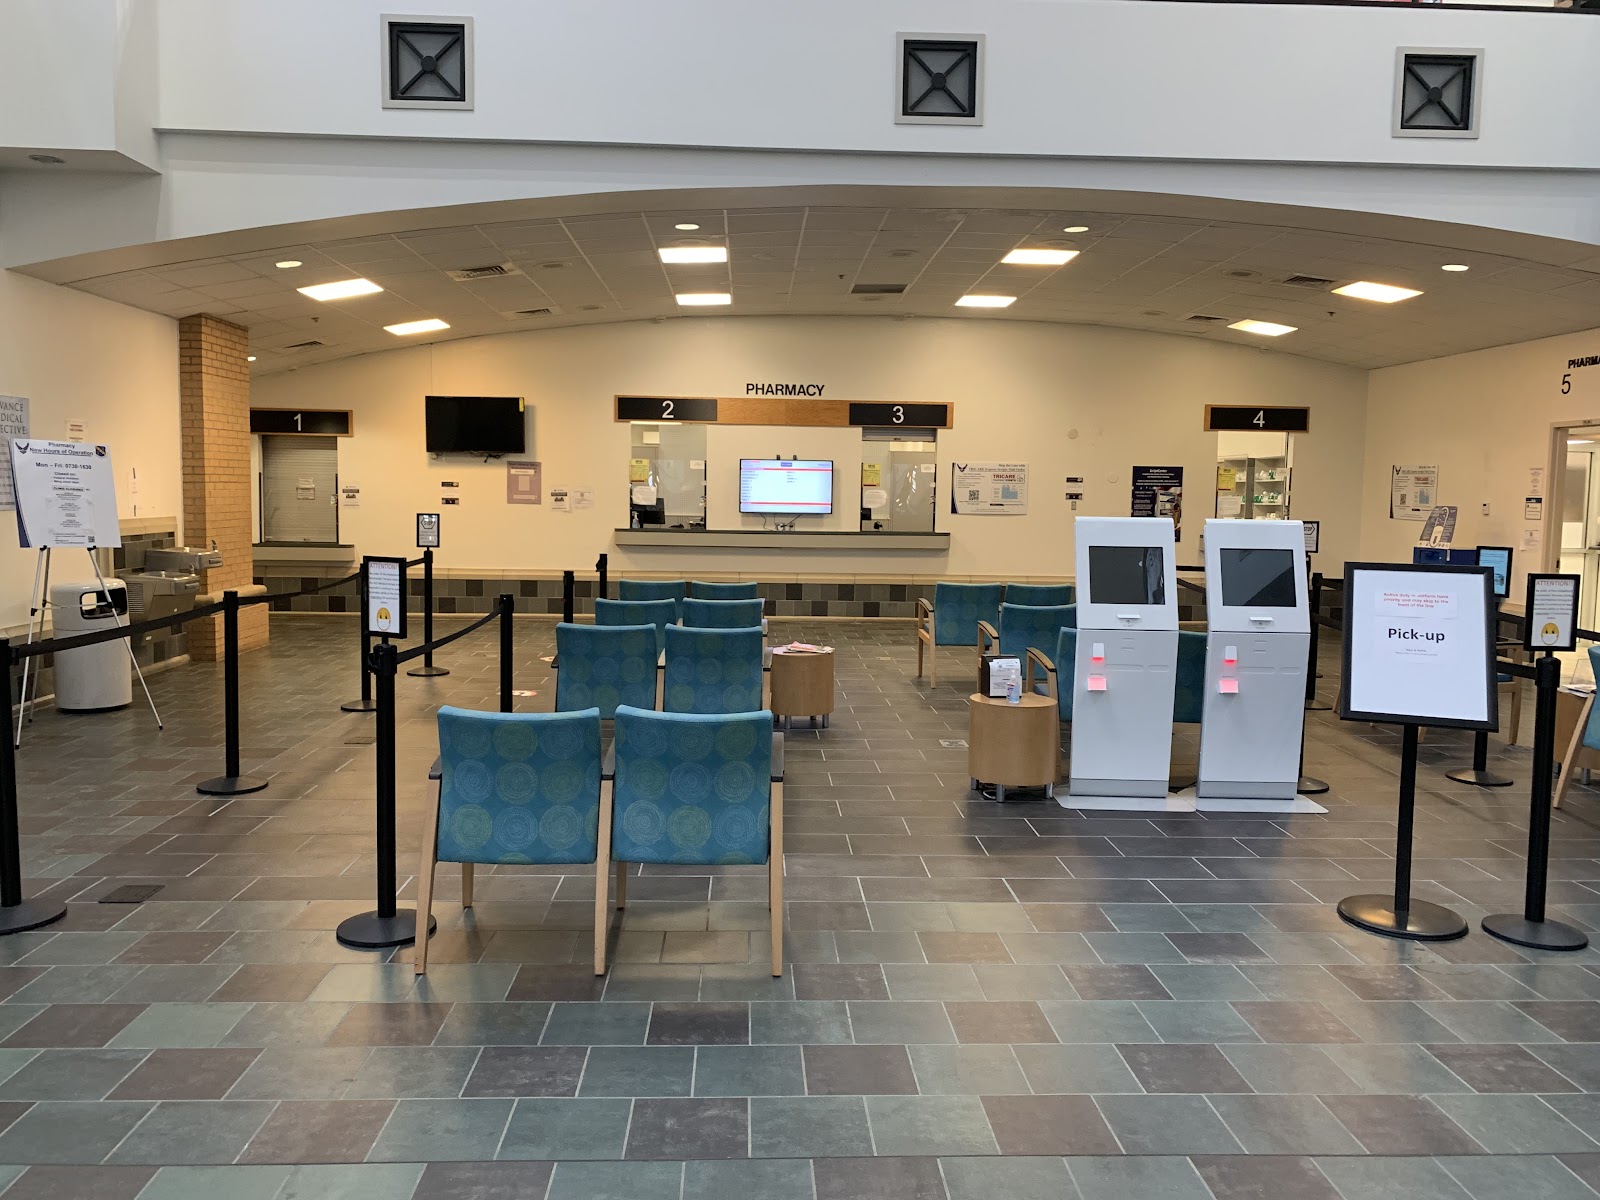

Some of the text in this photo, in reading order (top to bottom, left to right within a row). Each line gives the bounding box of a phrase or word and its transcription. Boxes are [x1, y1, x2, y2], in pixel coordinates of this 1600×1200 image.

[746, 384, 825, 396] PHARMACY
[1562, 374, 1571, 394] 5
[662, 400, 674, 418] 2
[892, 406, 905, 424] 3
[294, 413, 302, 432] 1
[1252, 410, 1266, 428] 4
[1388, 628, 1445, 643] Pick-up
